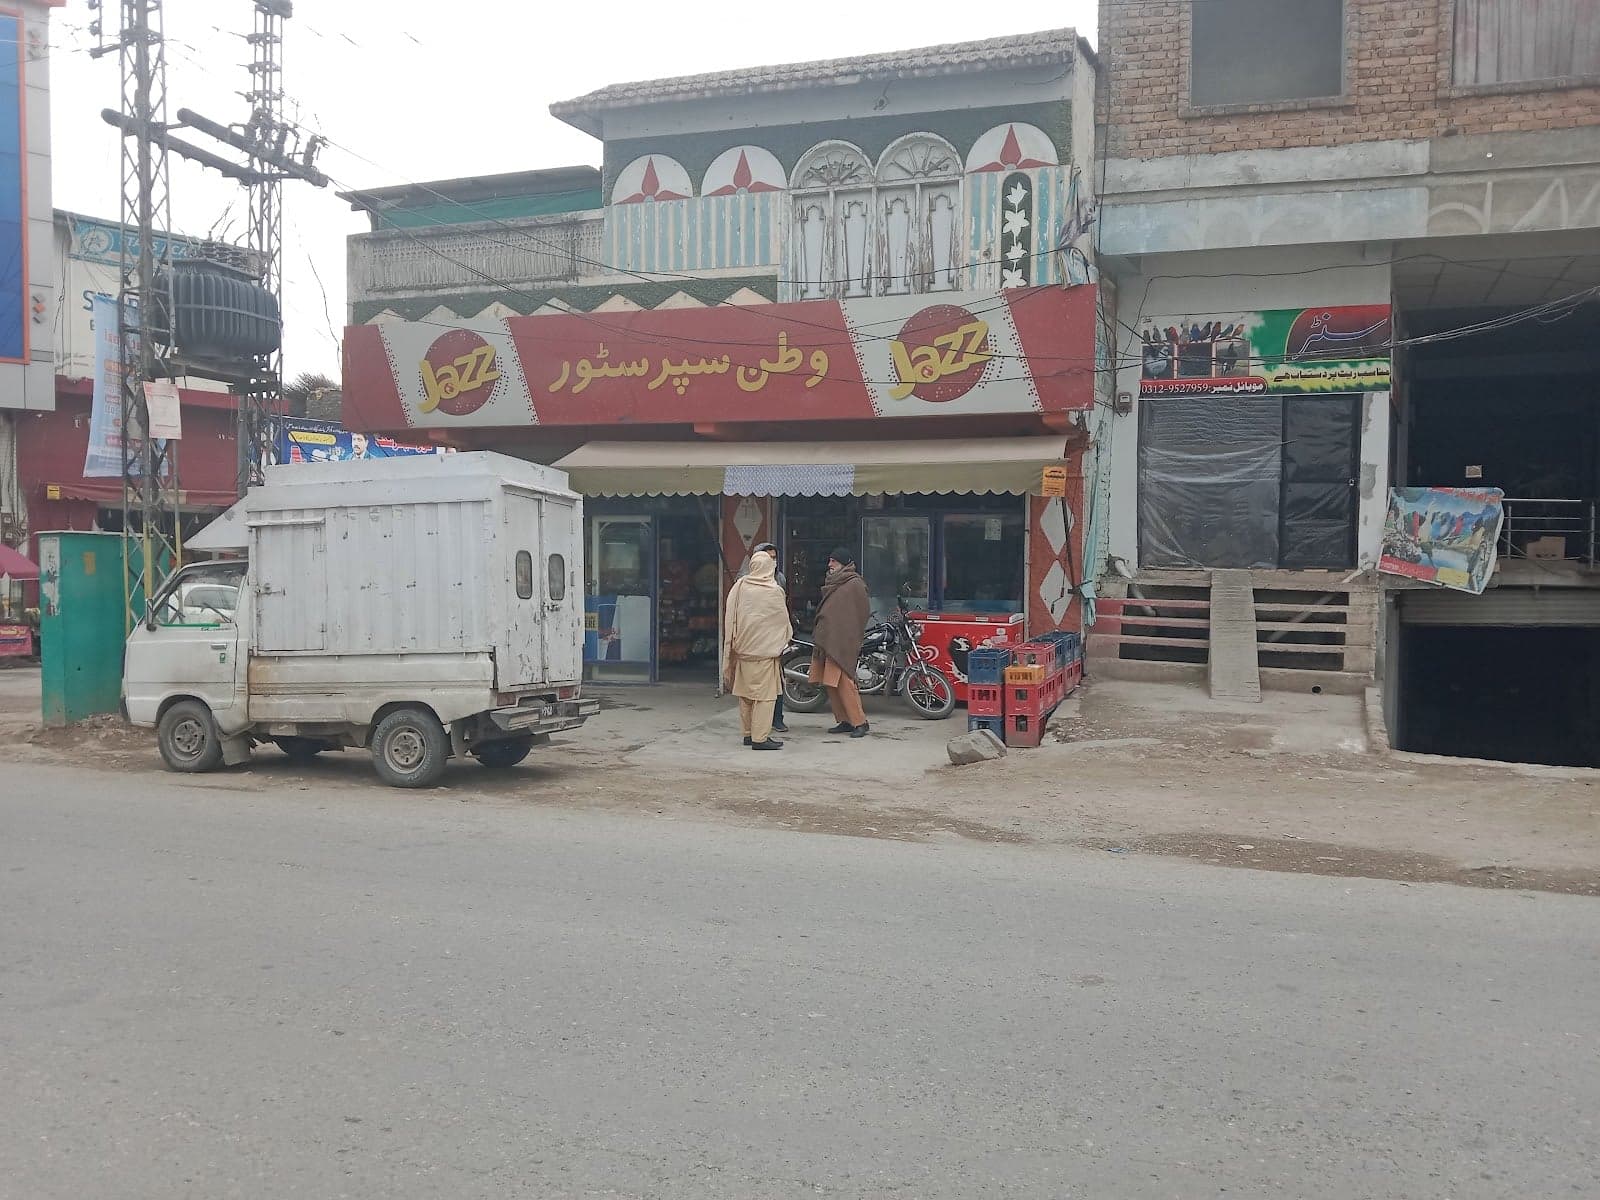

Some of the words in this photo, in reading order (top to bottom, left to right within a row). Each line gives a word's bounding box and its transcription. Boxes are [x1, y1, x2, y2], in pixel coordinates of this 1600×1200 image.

[417, 344, 501, 414] Jazz
[548, 342, 649, 394] سٹور
[647, 354, 731, 395] سپر
[736, 331, 829, 392] وطن
[888, 320, 994, 401] Jazz
[1141, 383, 1208, 394] 0312-9527959
[1233, 381, 1264, 393] موبائل
